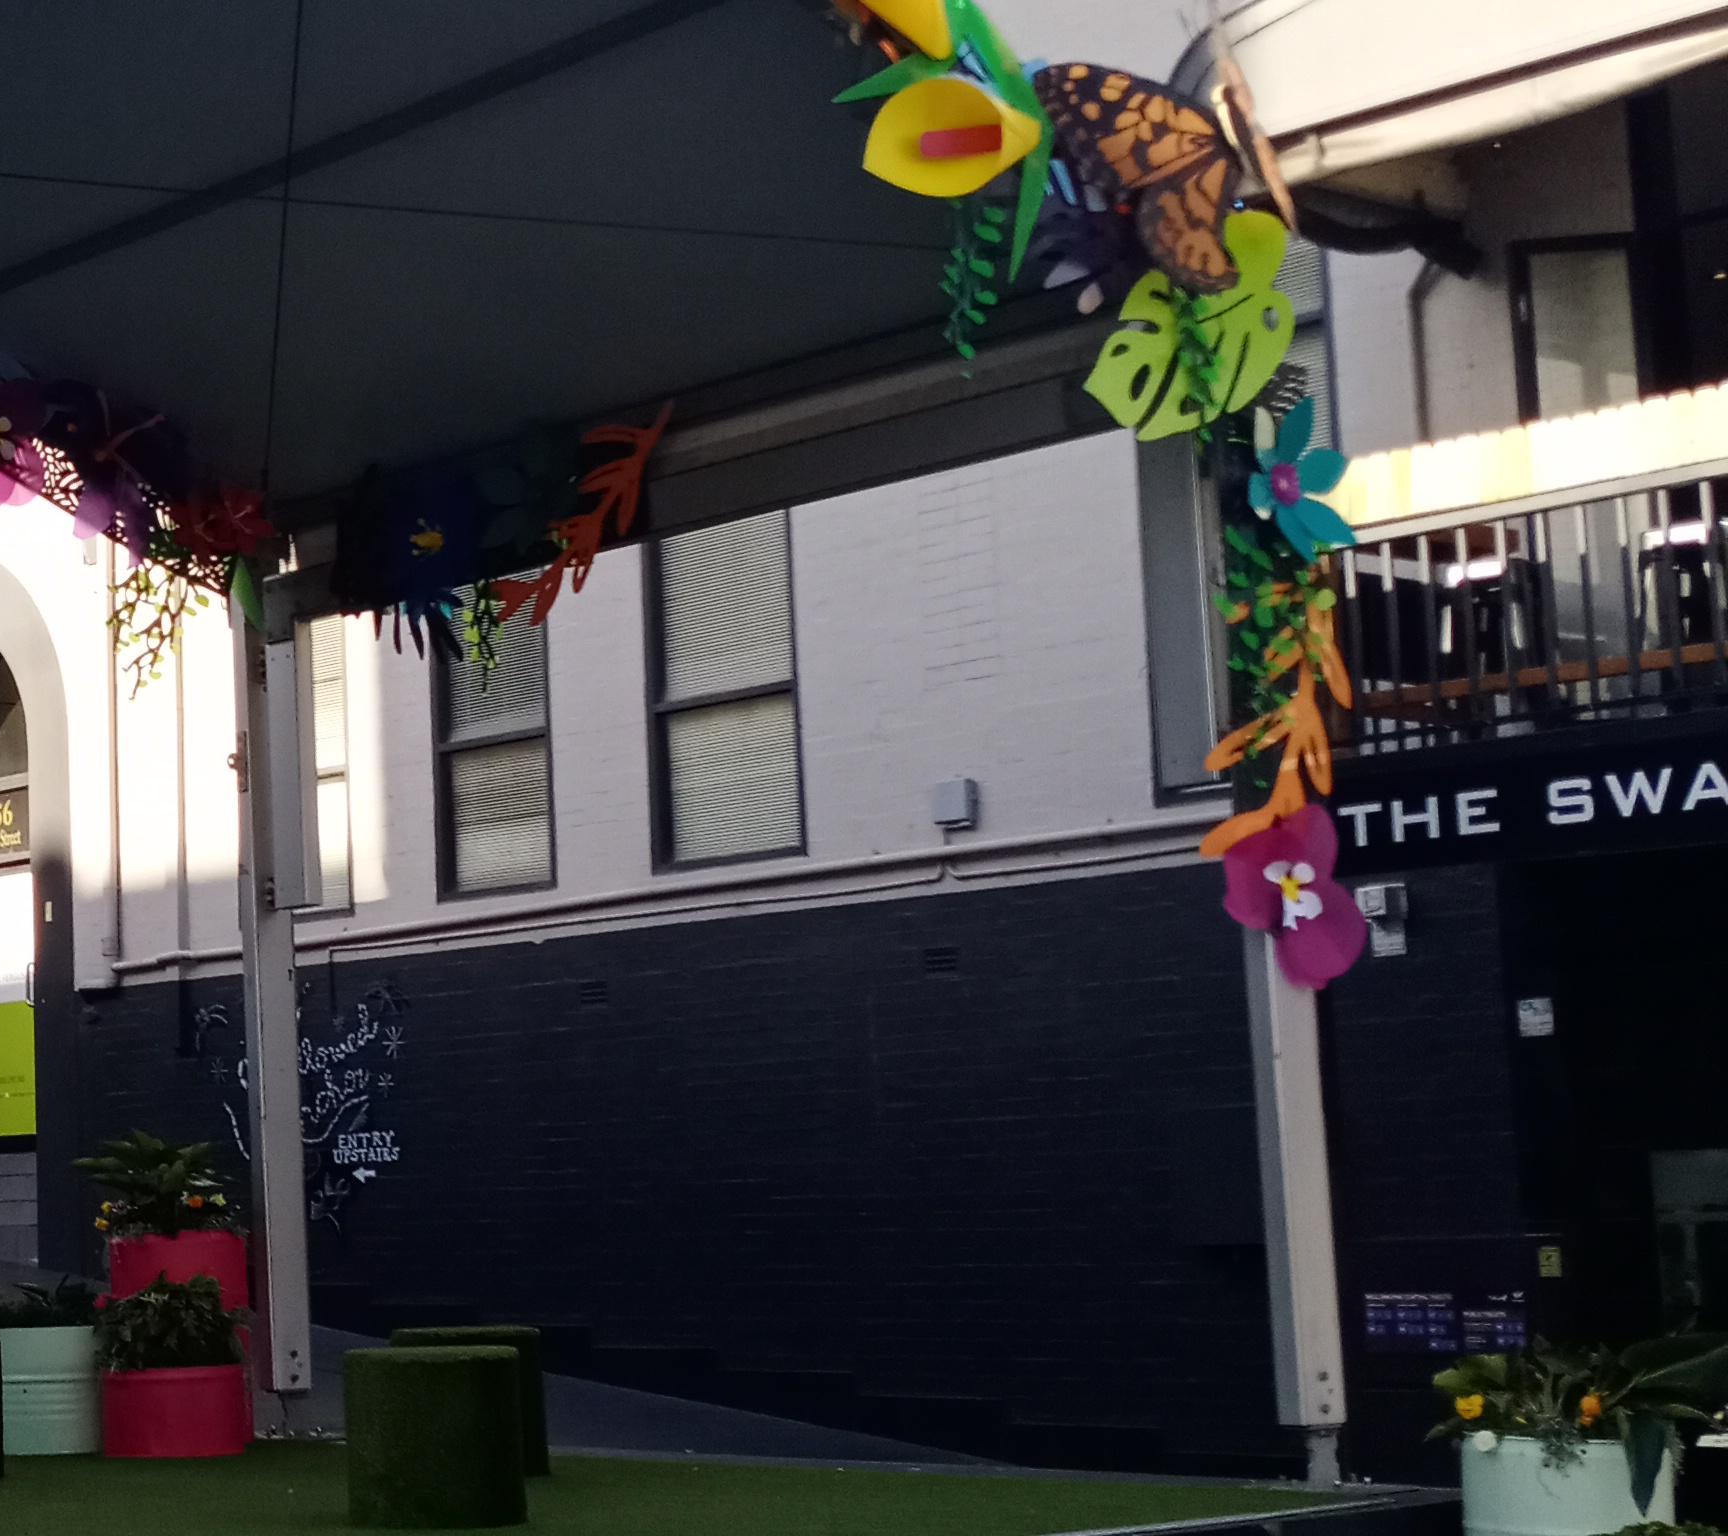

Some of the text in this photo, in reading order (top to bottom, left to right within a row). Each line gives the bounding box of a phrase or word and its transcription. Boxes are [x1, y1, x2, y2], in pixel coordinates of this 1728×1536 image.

[1337, 761, 1728, 847] THE SWA
[0, 829, 22, 848] Street
[338, 1129, 395, 1149] ENTRY
[332, 1146, 400, 1164] UPSTAIRS
